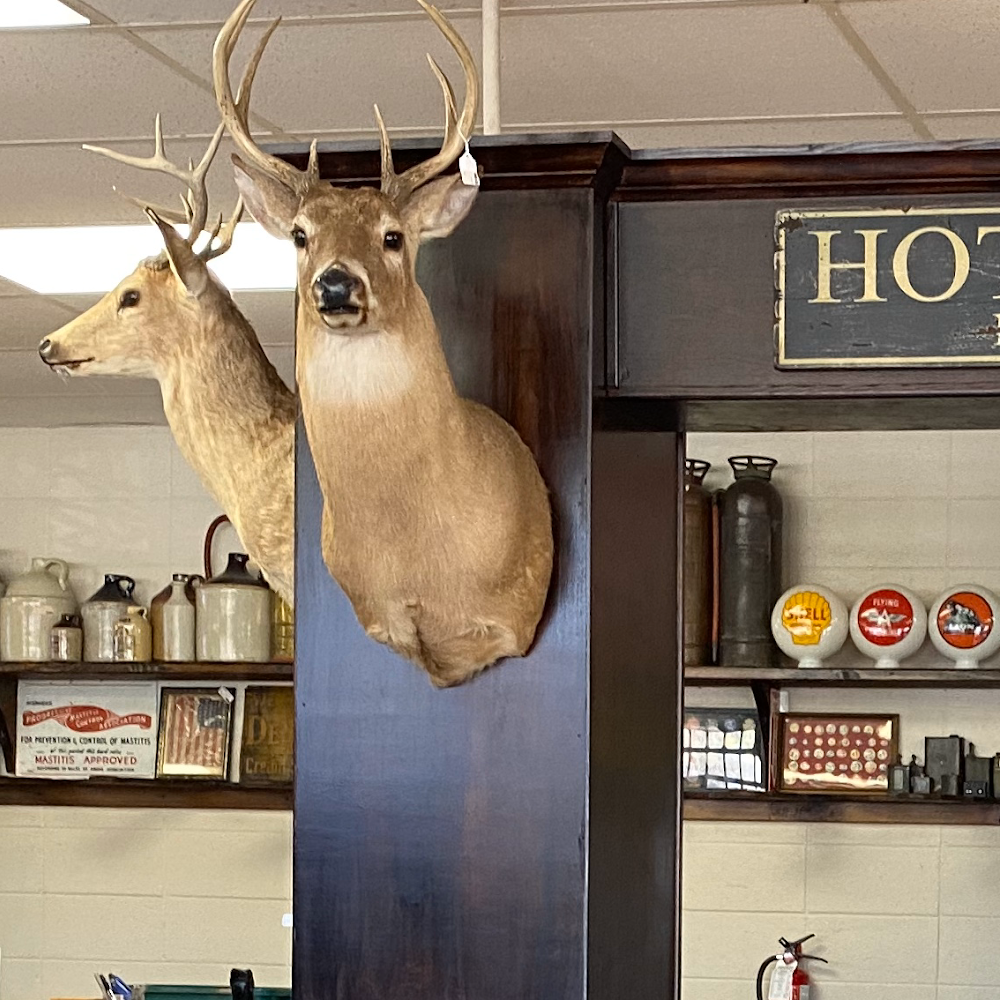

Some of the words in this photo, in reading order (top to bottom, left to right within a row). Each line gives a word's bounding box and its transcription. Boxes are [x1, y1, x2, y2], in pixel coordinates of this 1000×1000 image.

[872, 598, 900, 607] FLYING
[20, 736, 32, 744] FOR
[34, 736, 71, 745] PREVENTION
[79, 736, 107, 745] CONTROL
[120, 737, 151, 746] MASTITIS
[35, 755, 75, 765] MASTITIS
[83, 755, 138, 765] APPROVED
